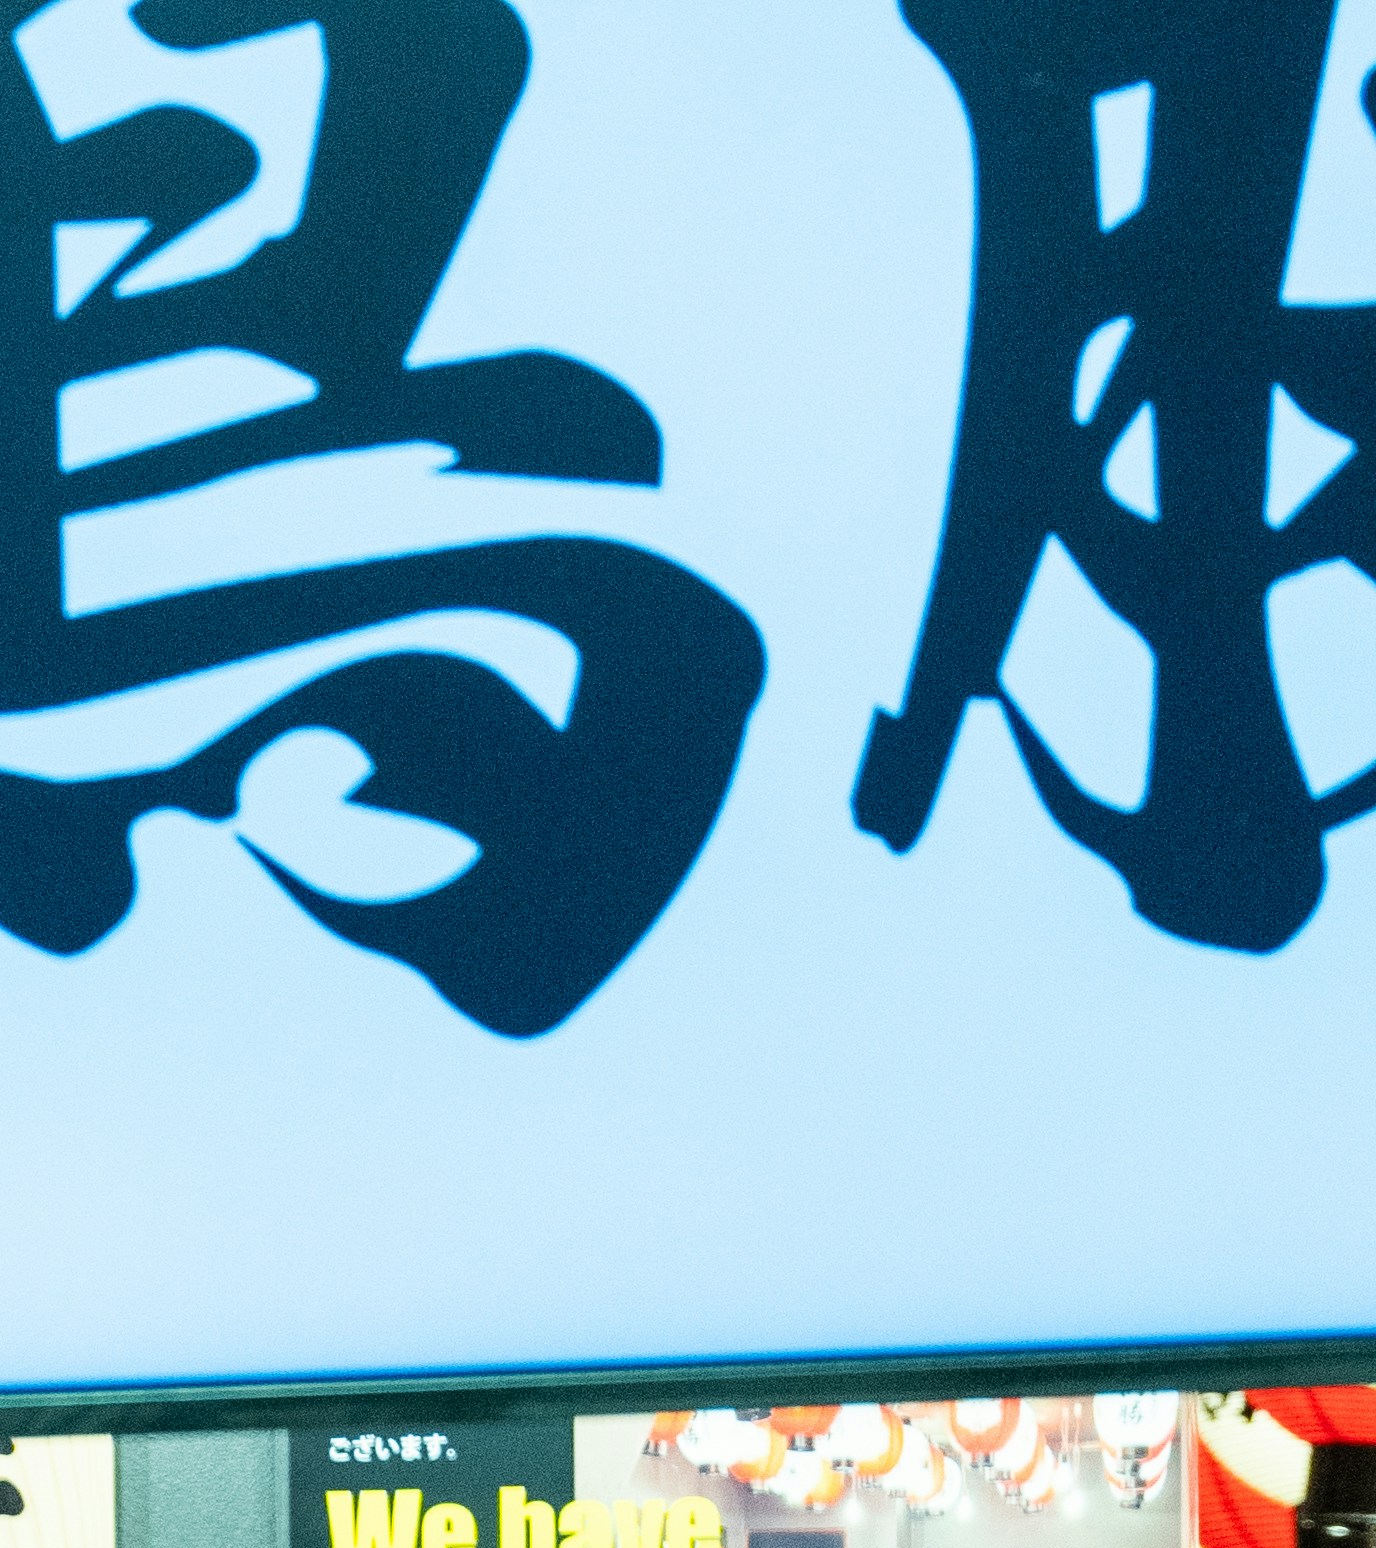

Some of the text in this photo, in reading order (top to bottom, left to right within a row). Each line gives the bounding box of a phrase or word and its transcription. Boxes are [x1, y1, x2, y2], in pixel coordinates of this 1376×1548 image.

[328, 1433, 457, 1461] ございます。
